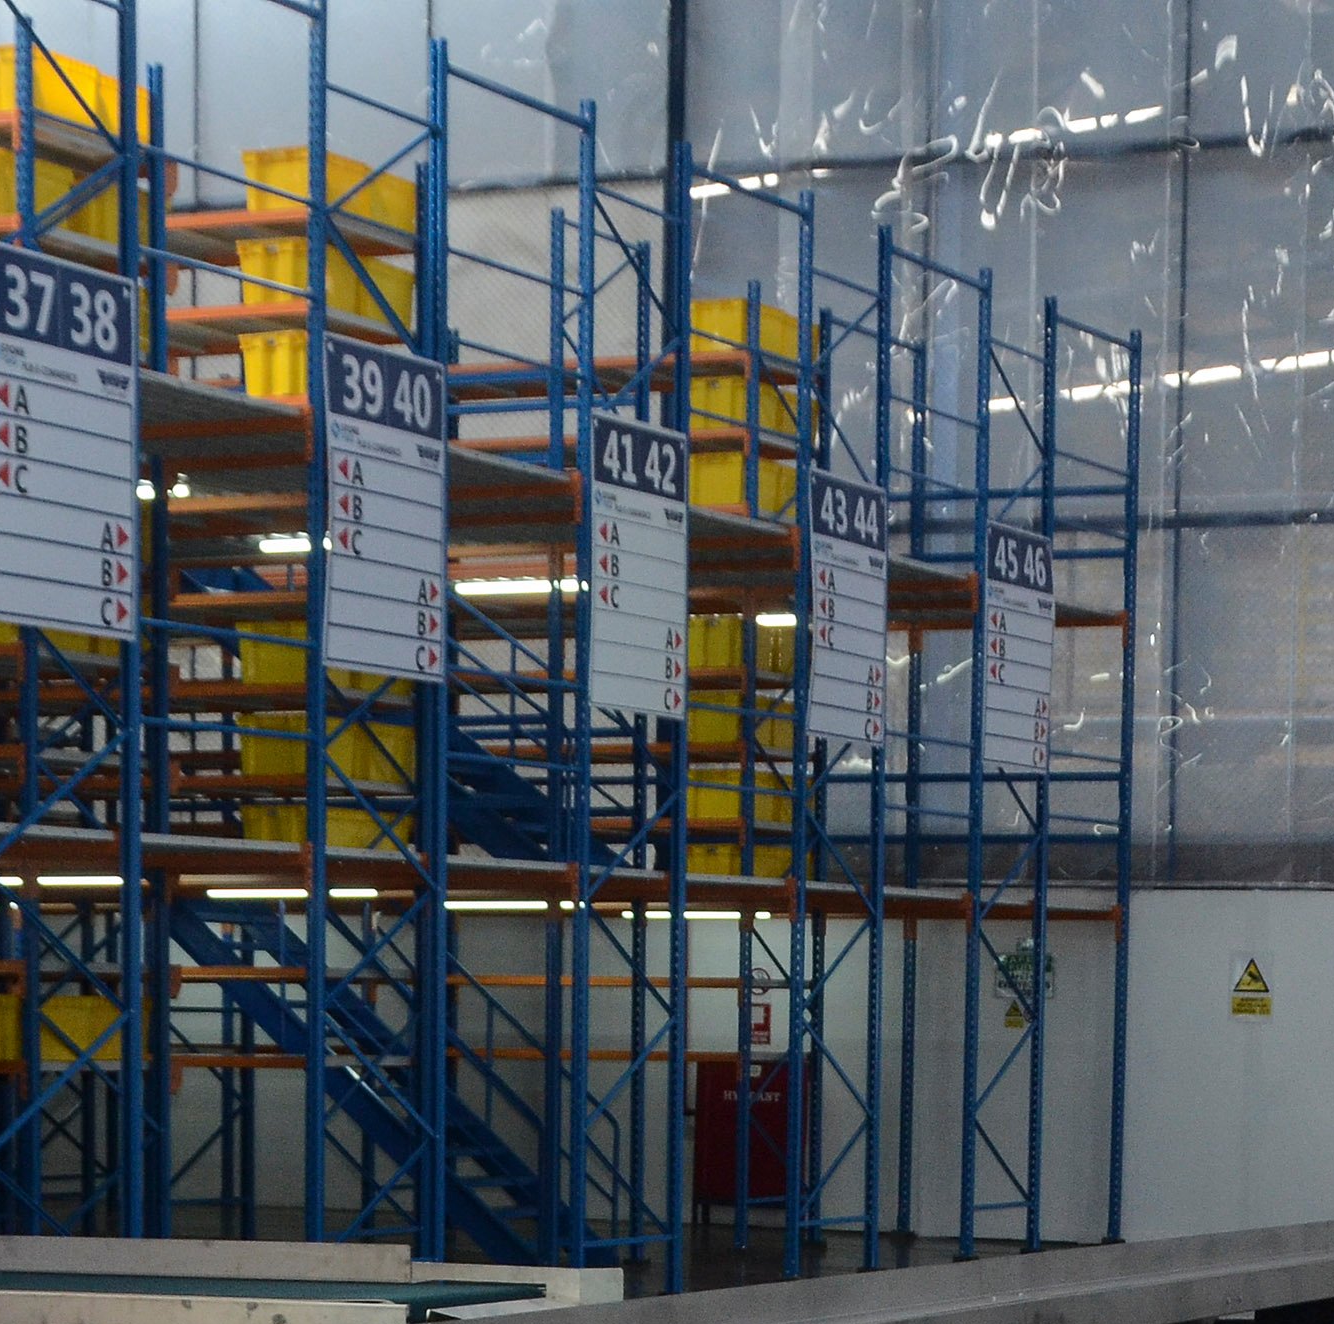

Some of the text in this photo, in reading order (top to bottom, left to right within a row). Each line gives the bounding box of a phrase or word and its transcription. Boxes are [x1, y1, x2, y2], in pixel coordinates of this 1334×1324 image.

[4, 263, 118, 353] 37 38
[13, 384, 30, 416] A
[342, 354, 432, 429] 39 40
[15, 425, 28, 455] B
[352, 460, 364, 486] A
[602, 429, 677, 494] 41 42
[14, 464, 28, 494] C
[352, 495, 363, 520] B
[821, 486, 878, 544] 43 44
[100, 522, 114, 554] A
[351, 529, 363, 556] C
[611, 521, 620, 546] A
[101, 559, 112, 587] B
[611, 554, 619, 578] B
[994, 536, 1046, 587] 45 46
[418, 578, 428, 607] A
[827, 570, 836, 592] A
[610, 585, 619, 609] C
[828, 598, 835, 618] B
[100, 597, 112, 626] C
[417, 611, 427, 636] B
[999, 612, 1007, 632] A
[665, 626, 674, 652] A
[827, 626, 835, 647] C
[999, 638, 1006, 658] B
[415, 645, 426, 670] C
[665, 657, 672, 679] B
[998, 664, 1005, 684] C
[664, 688, 671, 710] C
[724, 1090, 780, 1102] HYANT
